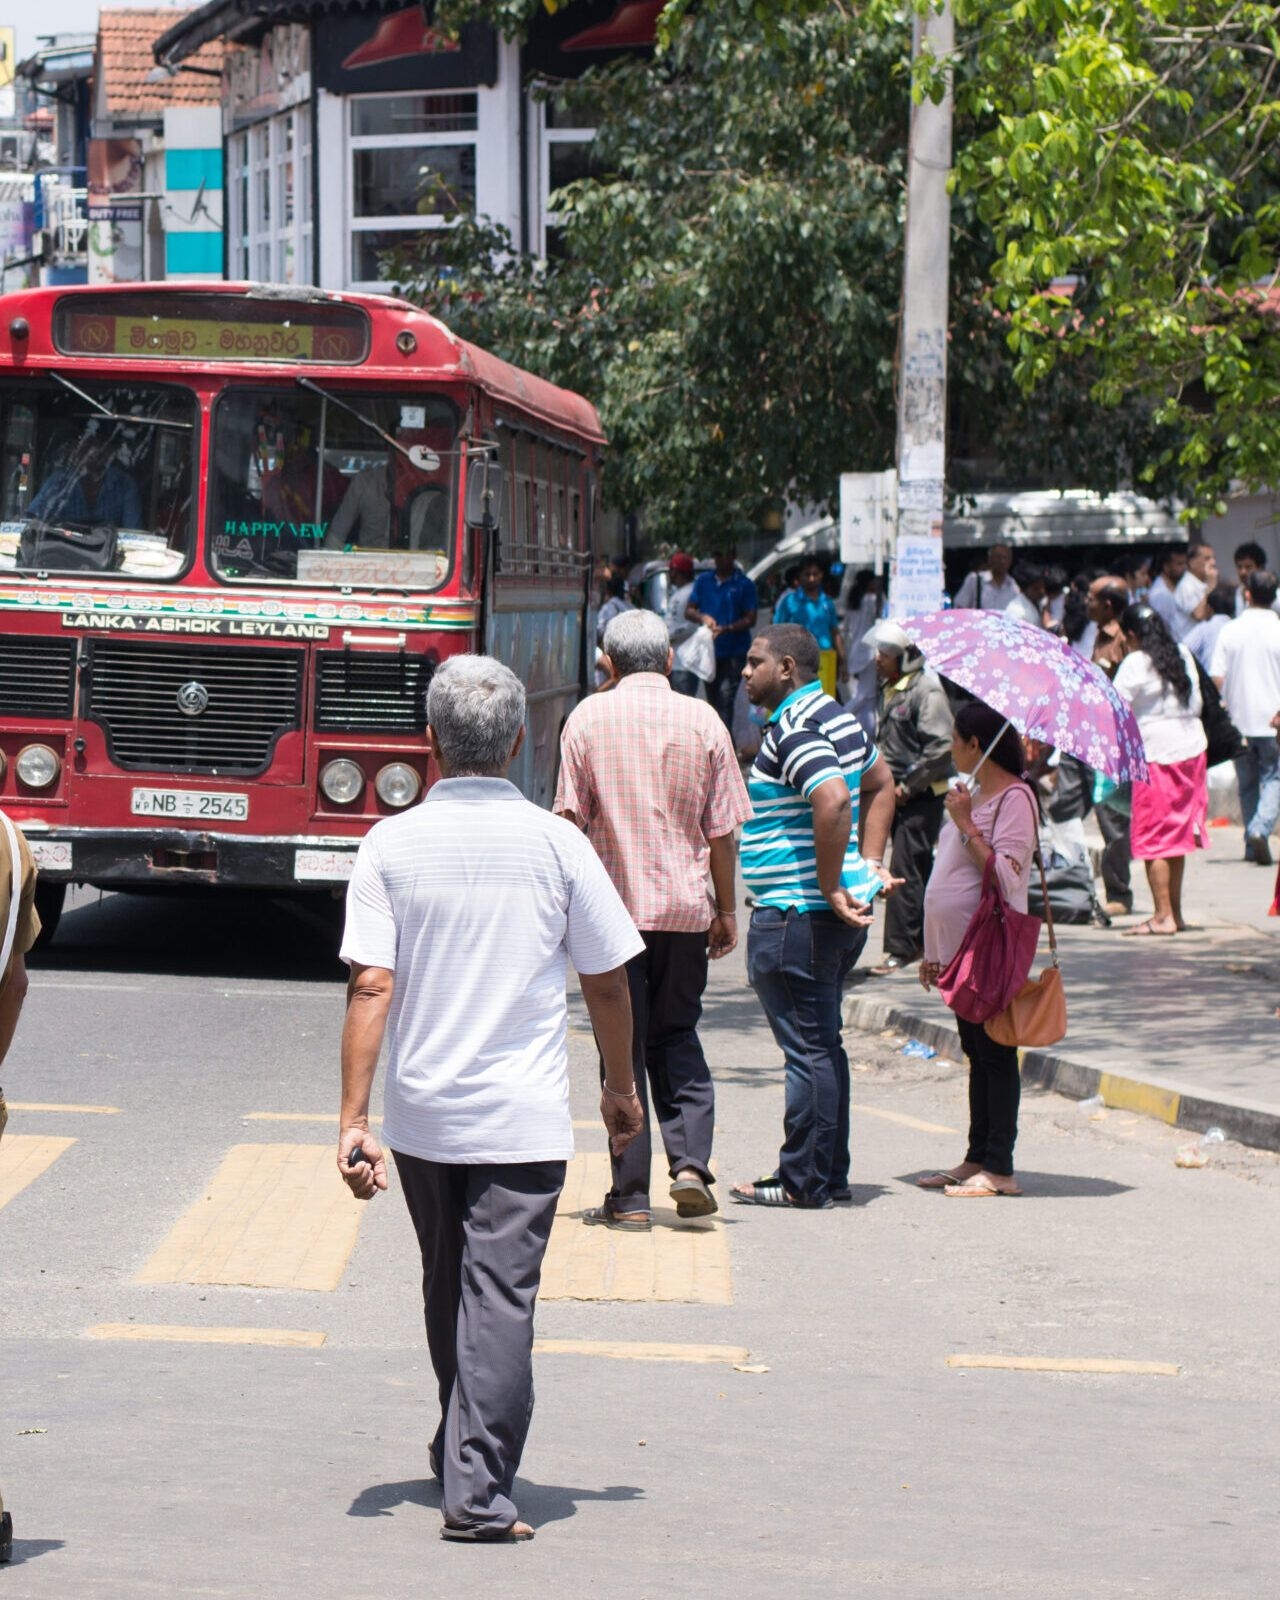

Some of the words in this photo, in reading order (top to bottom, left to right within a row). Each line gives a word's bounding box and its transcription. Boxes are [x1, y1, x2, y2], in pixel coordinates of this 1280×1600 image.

[225, 521, 285, 537] HAPPY
[62, 613, 136, 628] LANKA
[145, 617, 221, 632] ASHOK
[229, 620, 330, 639] LEYLAND
[153, 794, 176, 812] NB
[200, 797, 246, 816] 2545
